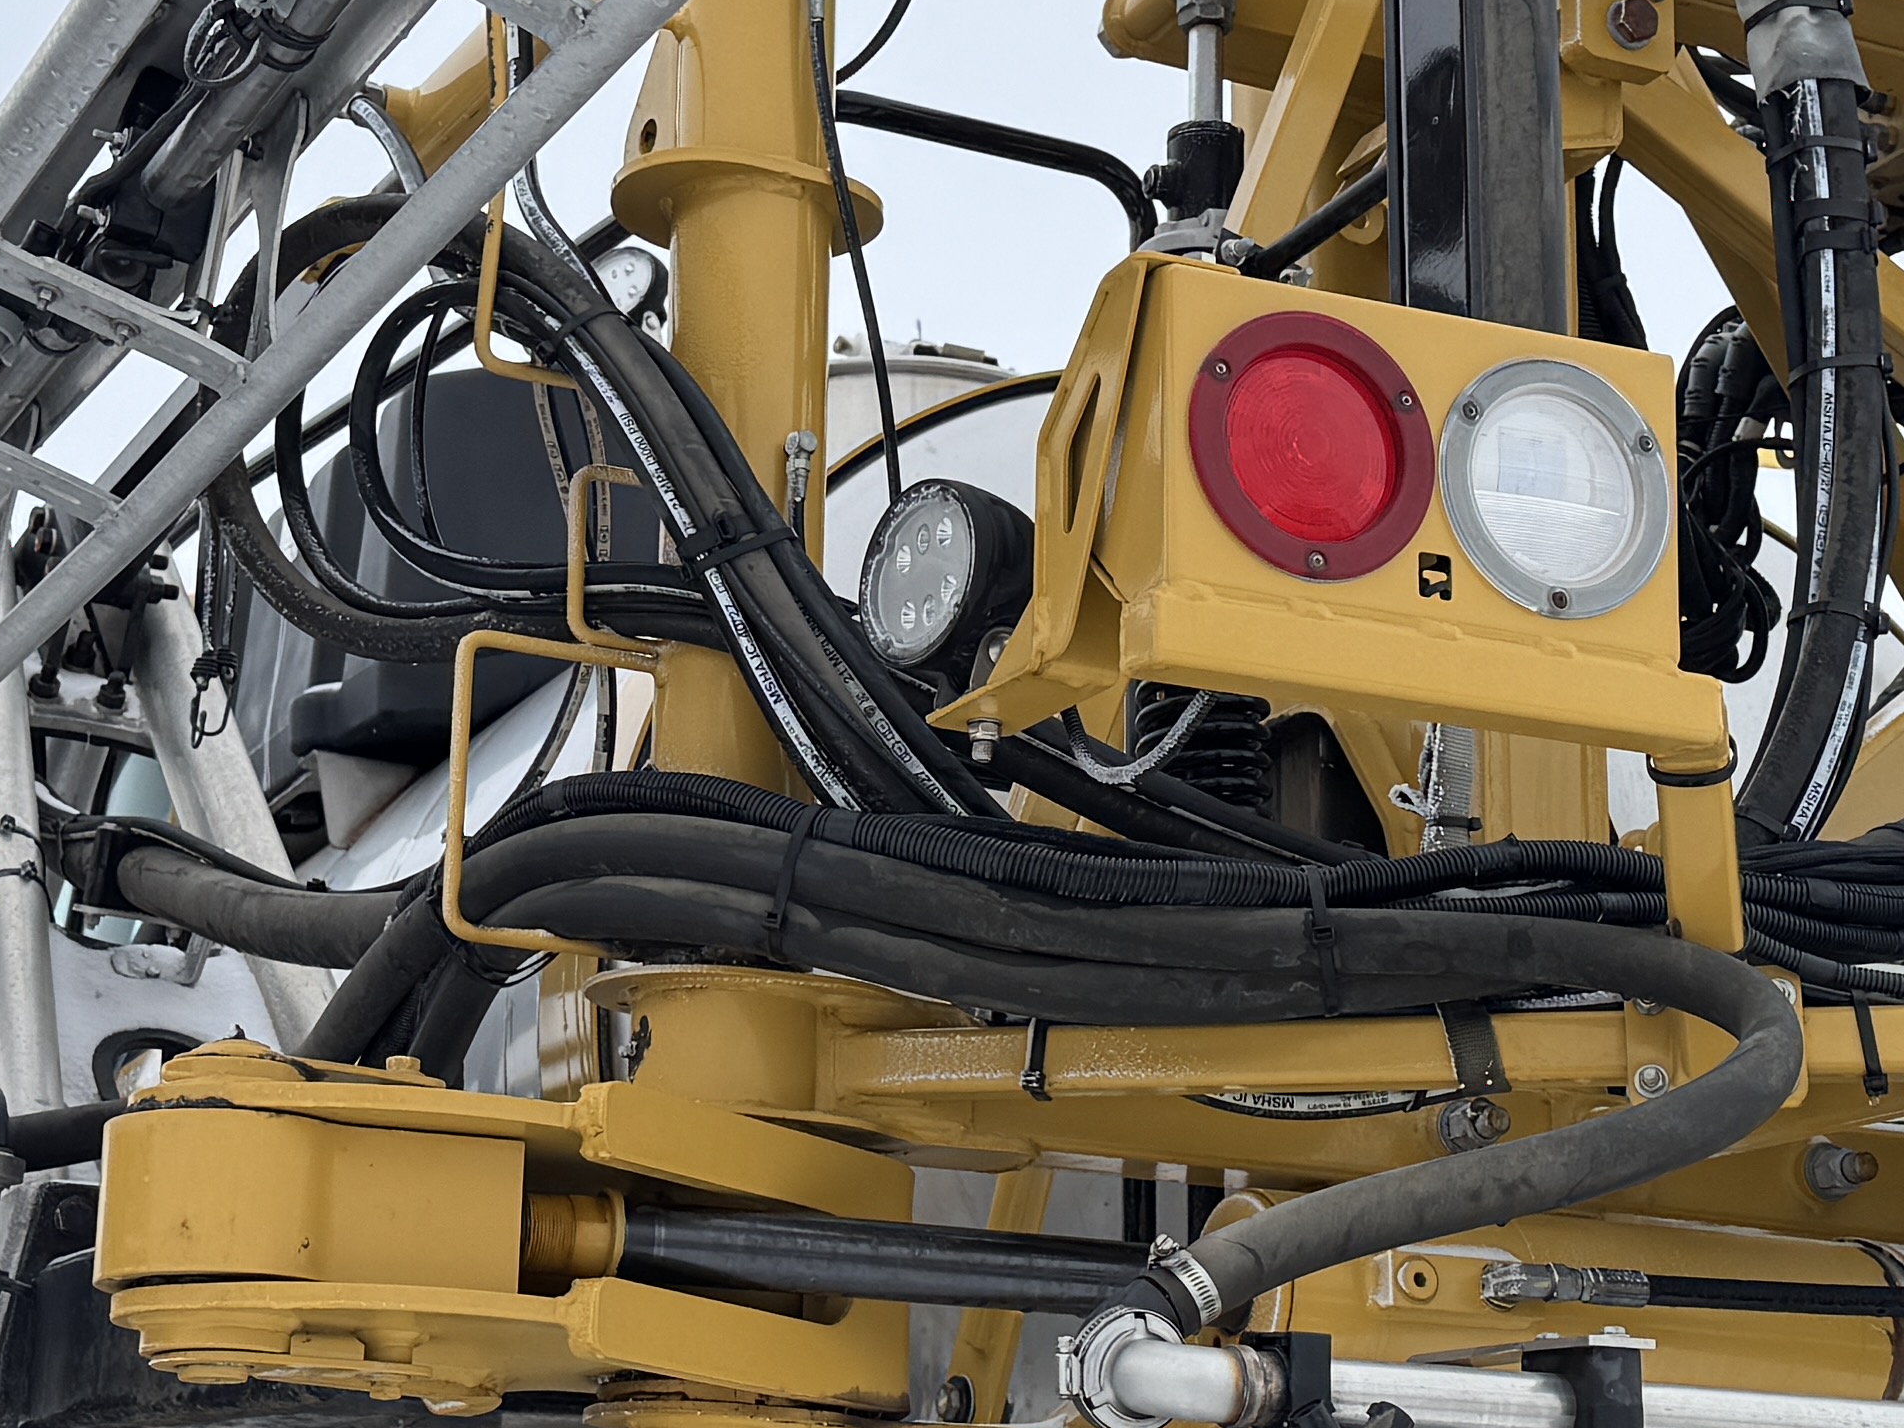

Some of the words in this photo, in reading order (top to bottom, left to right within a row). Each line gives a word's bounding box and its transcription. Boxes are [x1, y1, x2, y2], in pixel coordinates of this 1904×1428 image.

[1823, 392, 1833, 434] MSHA
[753, 661, 784, 706] MSHA
[1796, 782, 1822, 819] MSHA
[1252, 1094, 1294, 1108] MSHA
